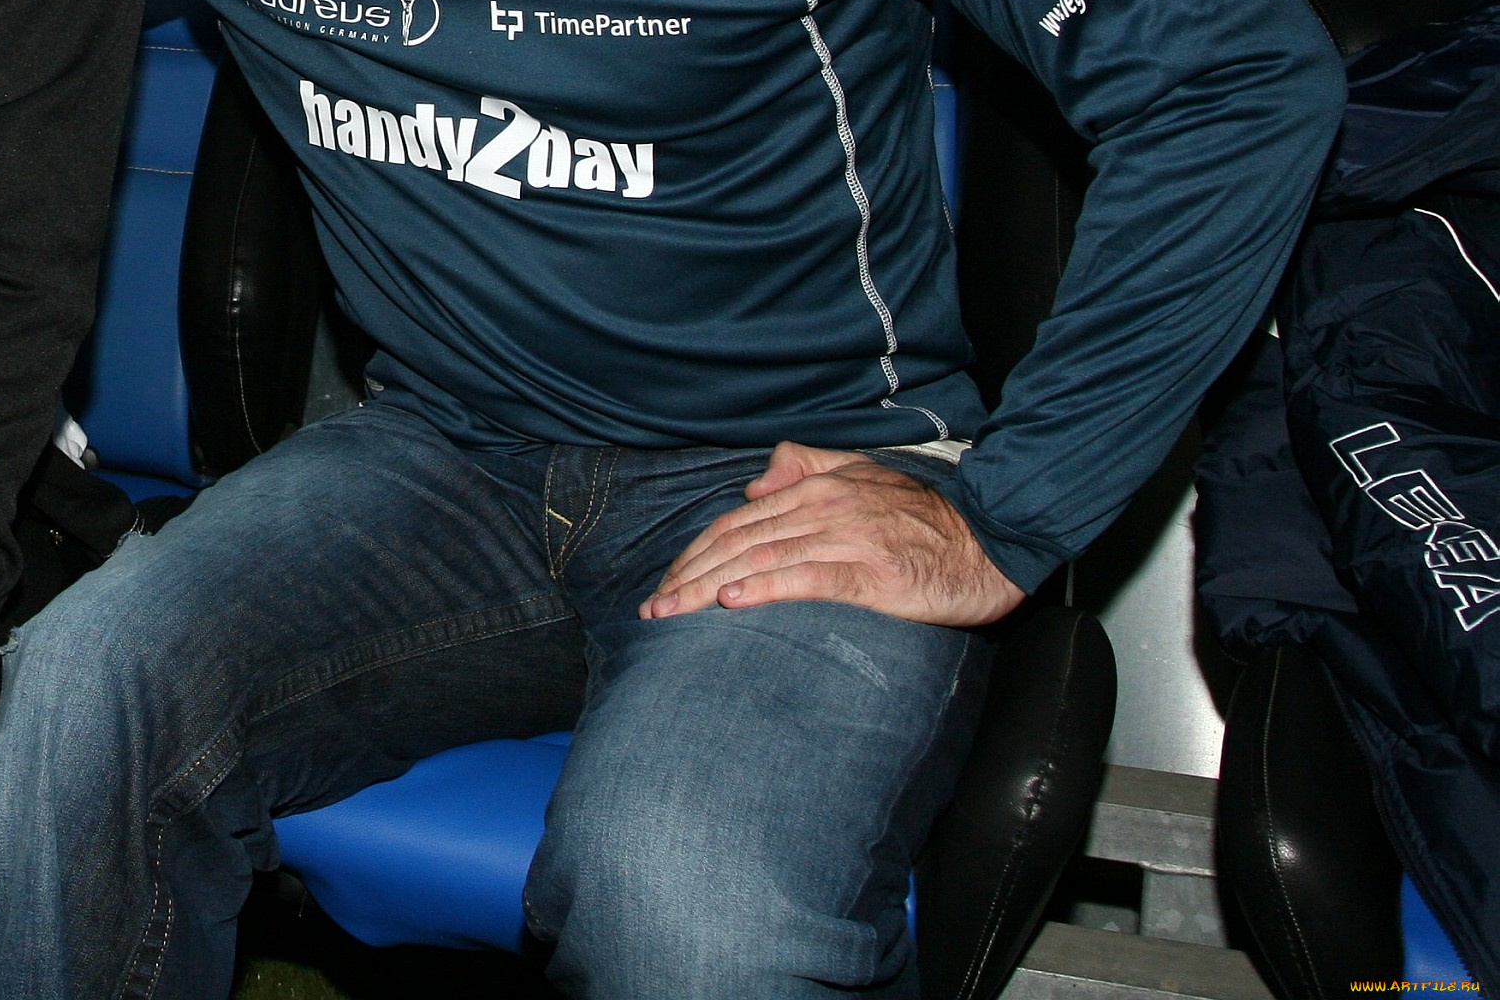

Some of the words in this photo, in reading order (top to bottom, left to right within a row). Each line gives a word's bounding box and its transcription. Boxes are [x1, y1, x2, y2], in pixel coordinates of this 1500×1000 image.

[319, 25, 390, 44] GERMANY
[533, 11, 691, 37] TimePartner
[299, 78, 655, 200] handy2day
